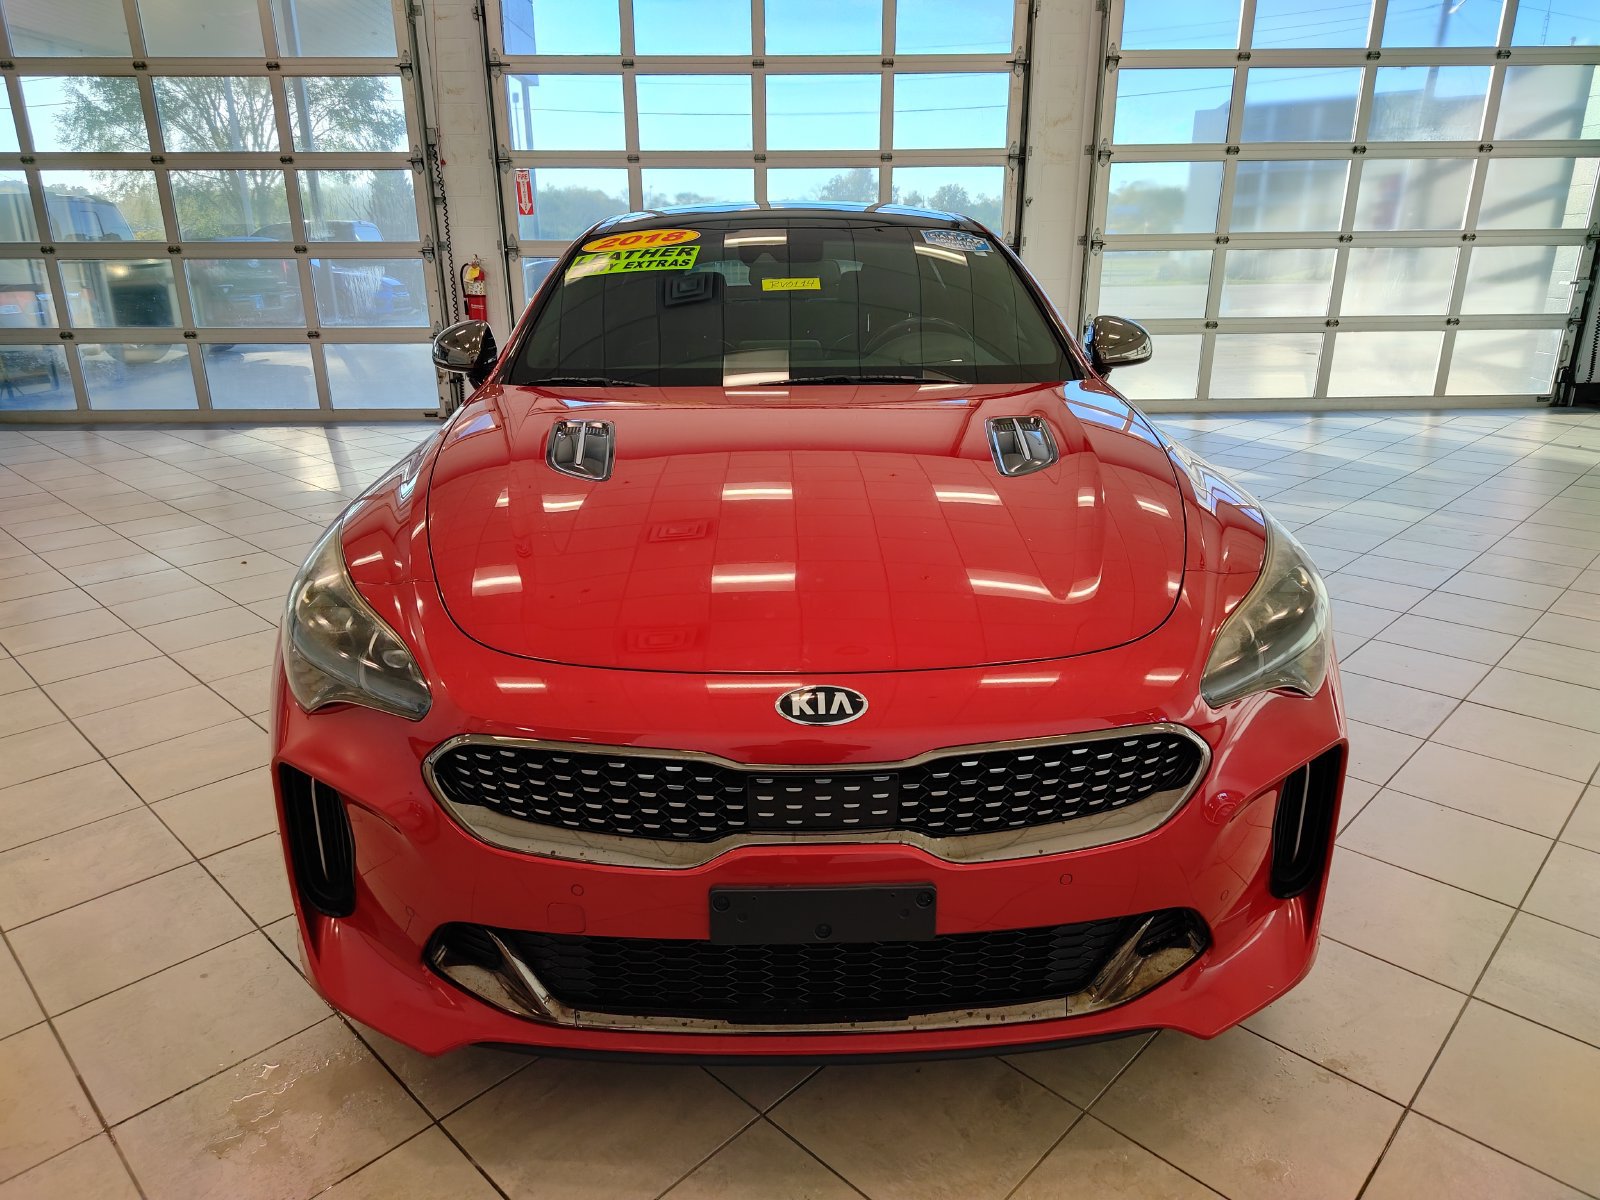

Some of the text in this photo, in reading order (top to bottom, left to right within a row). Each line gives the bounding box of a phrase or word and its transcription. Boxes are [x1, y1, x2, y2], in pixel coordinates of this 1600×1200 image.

[595, 231, 687, 250] 2018
[623, 258, 692, 270] EXTRAS
[790, 691, 853, 716] KIA
